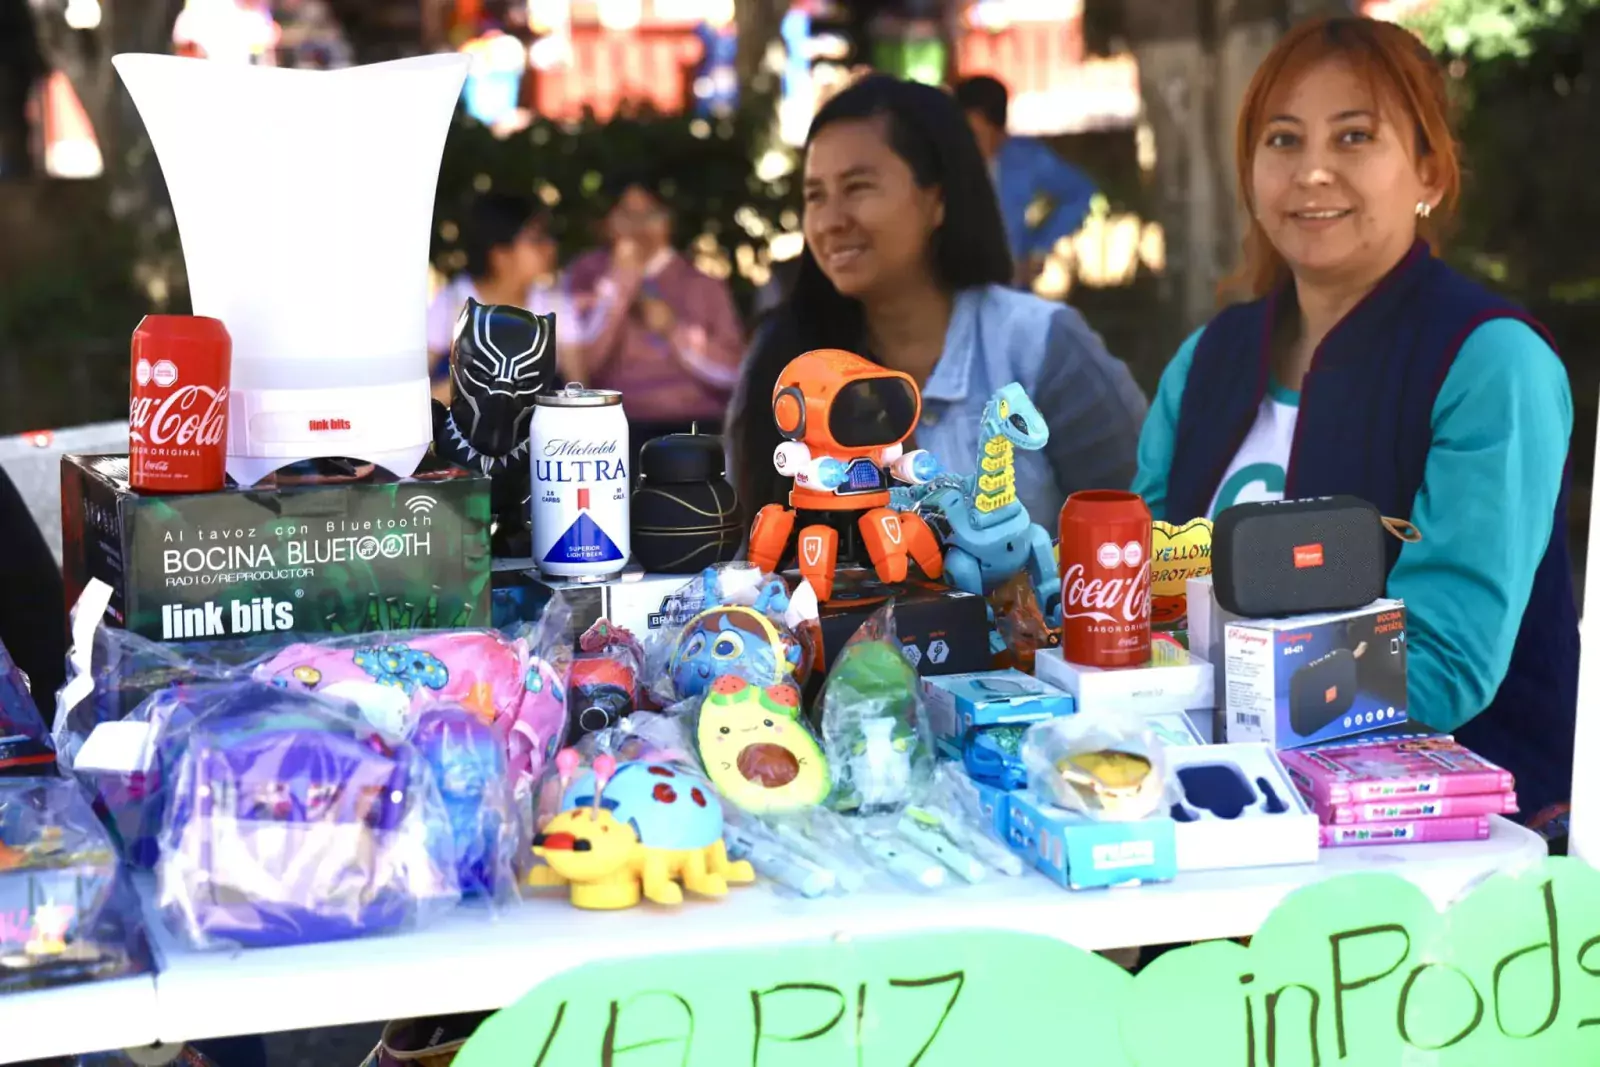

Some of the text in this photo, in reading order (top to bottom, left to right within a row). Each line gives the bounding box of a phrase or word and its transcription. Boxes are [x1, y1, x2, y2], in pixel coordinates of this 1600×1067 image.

[151, 448, 200, 457] ORIGINAL
[543, 438, 618, 457] Michelob
[536, 458, 626, 482] ULTRA
[275, 524, 308, 536] con
[326, 516, 432, 532] Bluetooth
[163, 532, 431, 574] BOCINA BLUETOOTH
[1155, 544, 1211, 562] YELLOW
[165, 567, 315, 587] RADIO/REPRODUCTOR
[162, 597, 294, 639] link bits
[1087, 624, 1122, 633] SABOR
